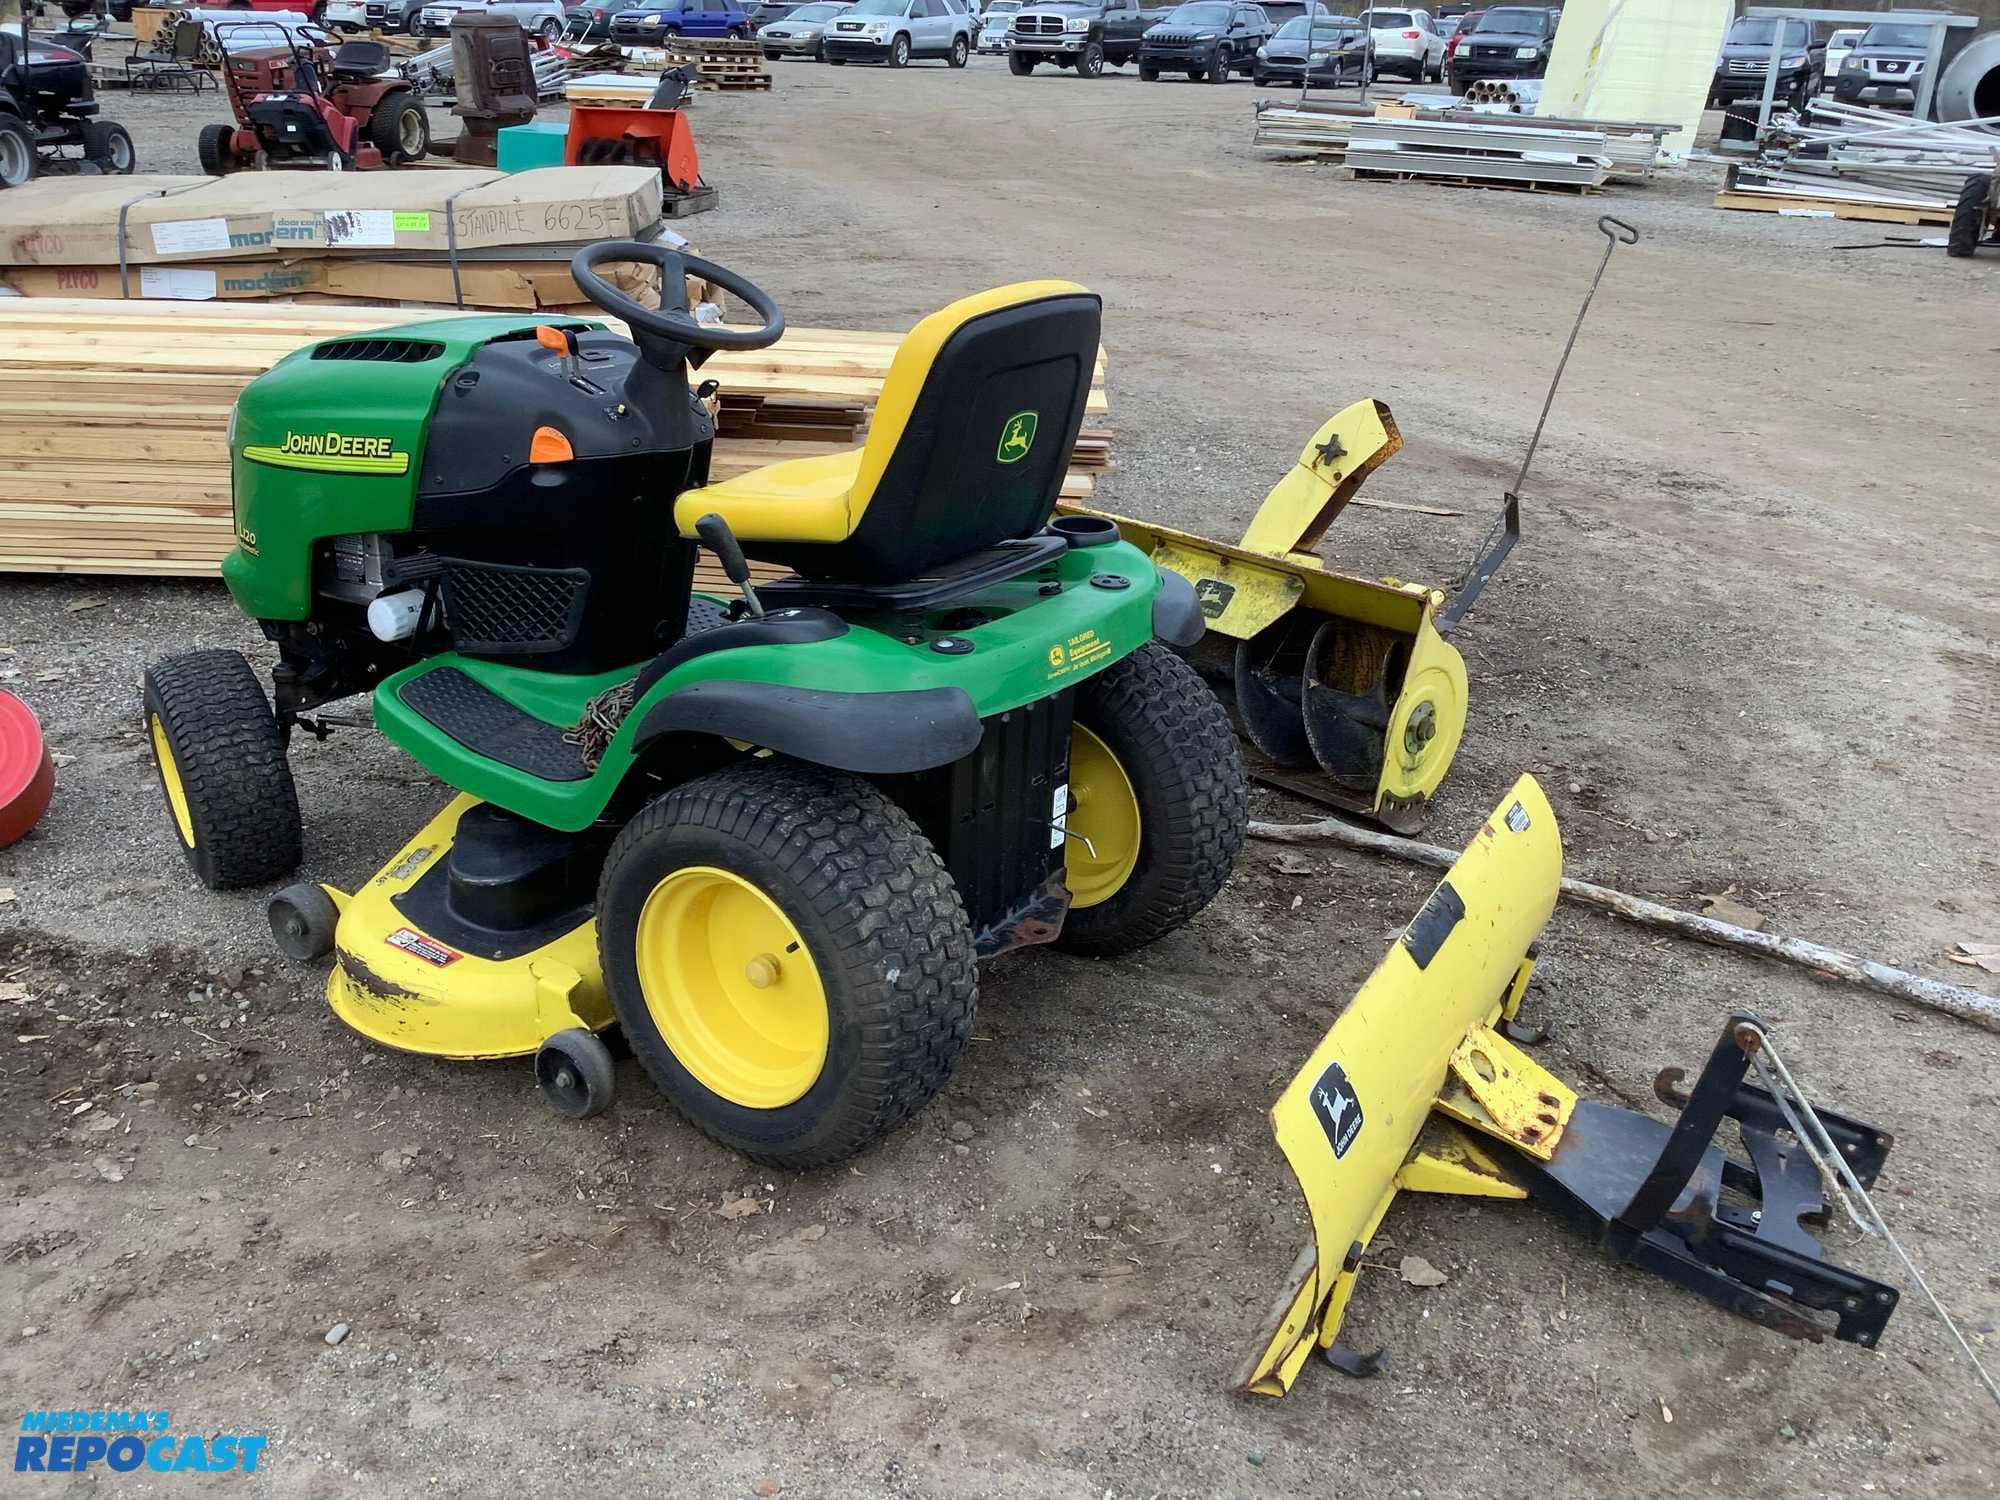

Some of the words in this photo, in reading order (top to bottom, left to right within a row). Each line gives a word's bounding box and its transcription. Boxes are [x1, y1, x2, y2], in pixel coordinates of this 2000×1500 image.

[455, 208, 534, 239] STANDALE
[239, 522, 257, 545] L120
[1336, 1133, 1349, 1156] JOHN
